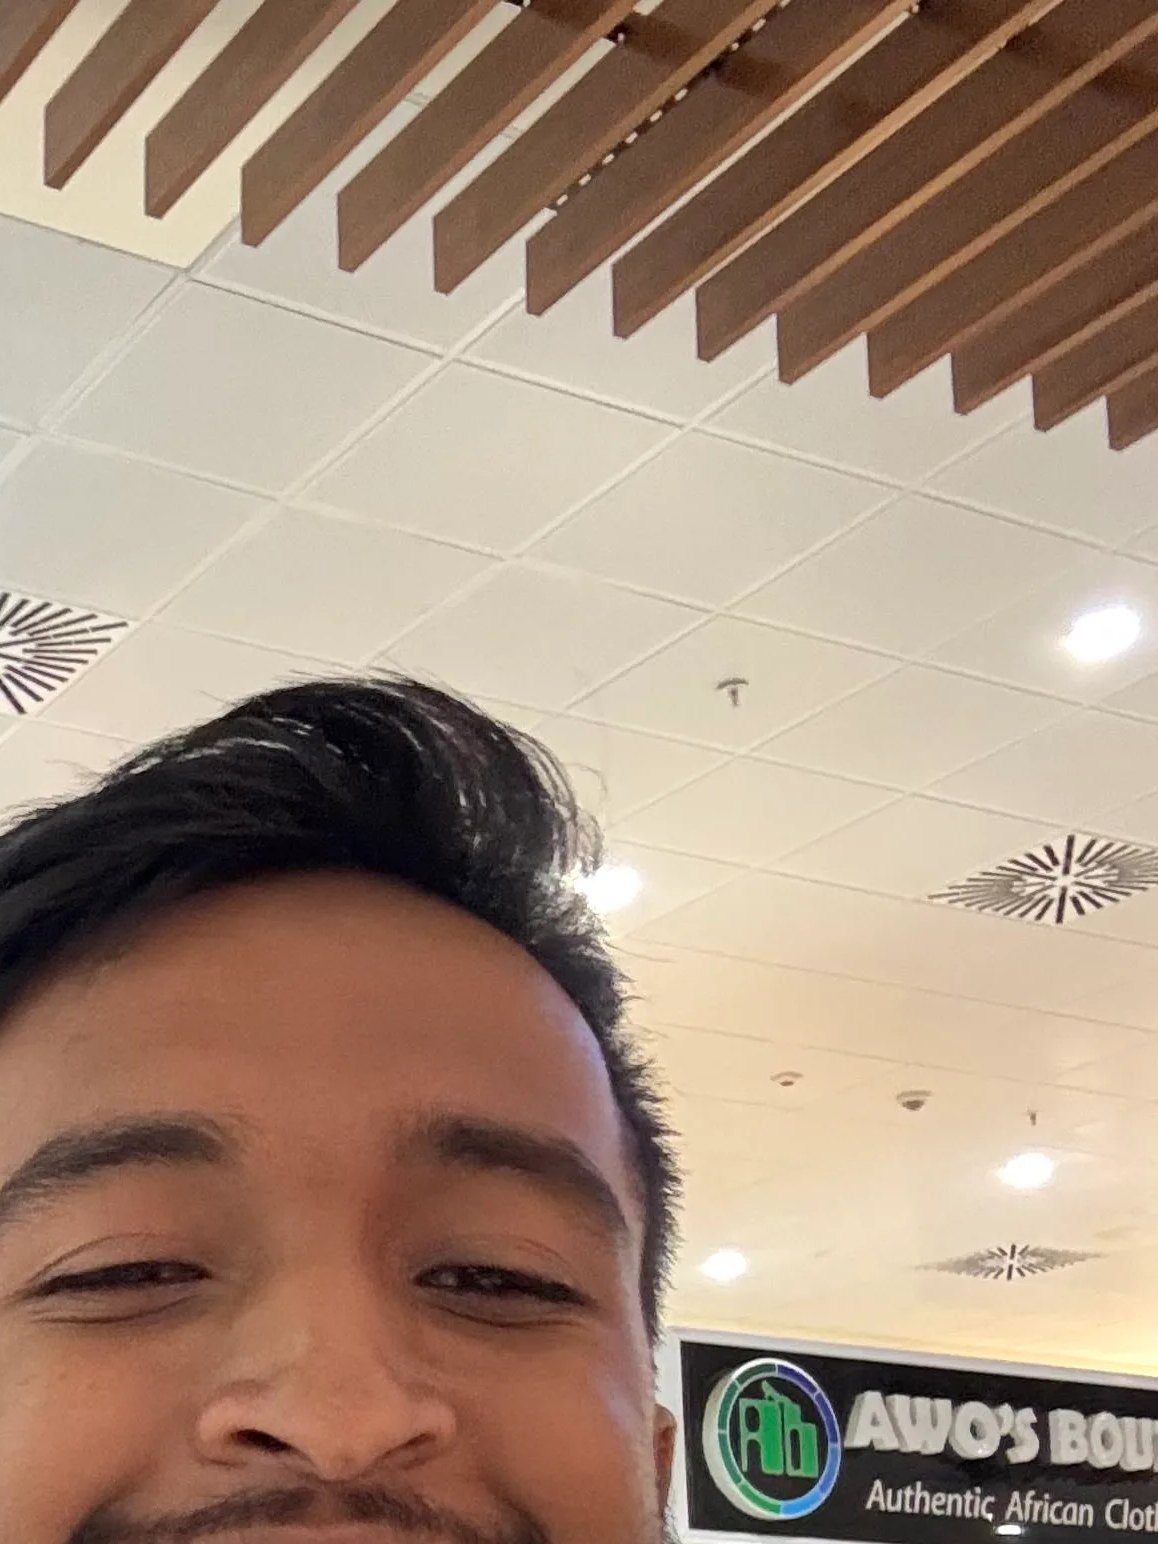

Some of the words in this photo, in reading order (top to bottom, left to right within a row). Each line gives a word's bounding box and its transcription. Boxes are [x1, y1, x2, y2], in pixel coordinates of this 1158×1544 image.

[843, 1391, 1040, 1464] AWO'S
[1049, 1408, 1158, 1472] BOU
[865, 1479, 995, 1519] Authentic
[1005, 1490, 1093, 1529] African
[1105, 1499, 1158, 1533] Clot
